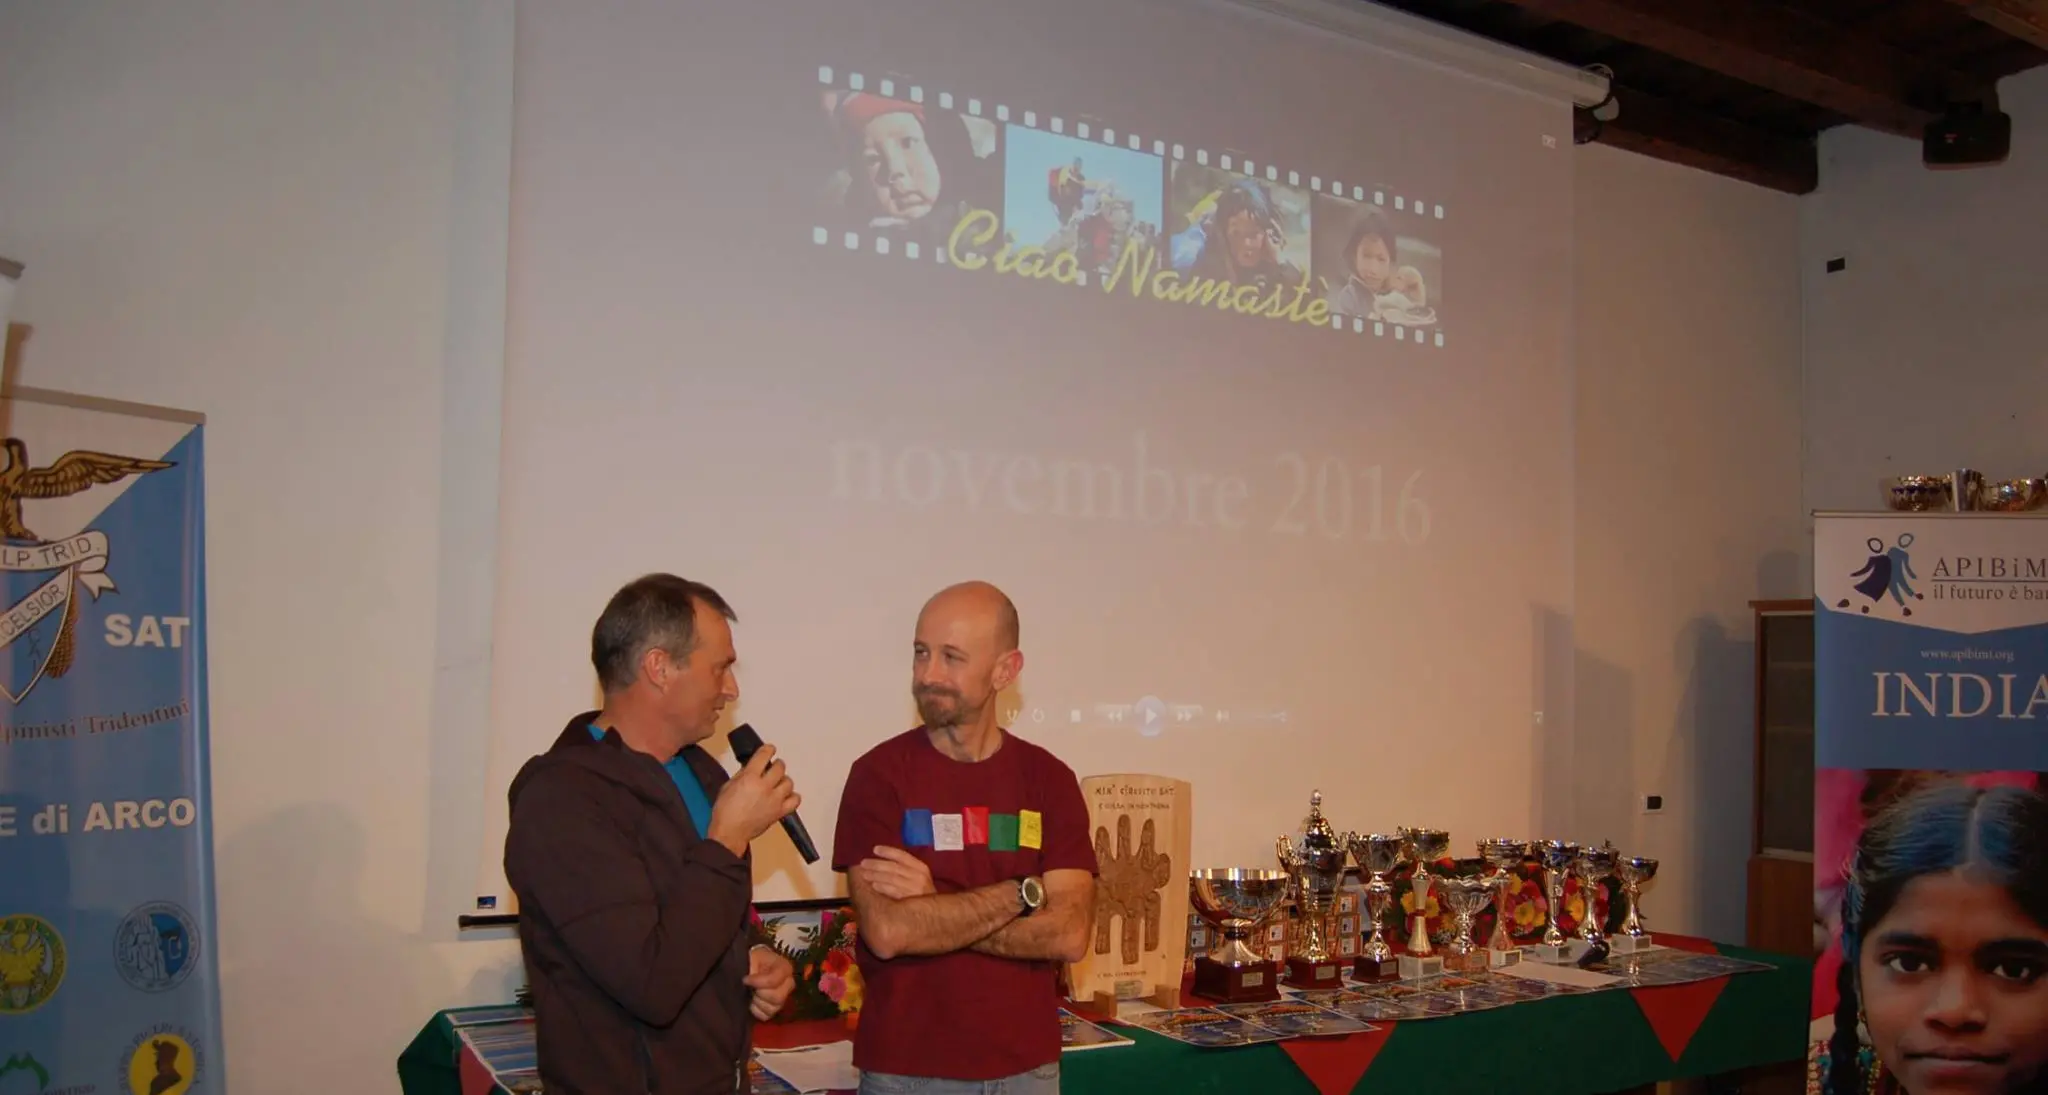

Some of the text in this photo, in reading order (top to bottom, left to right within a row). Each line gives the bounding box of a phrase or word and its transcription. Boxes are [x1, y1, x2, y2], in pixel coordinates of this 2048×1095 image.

[948, 208, 1330, 327] Ciao Namastè
[828, 429, 1433, 547] novembre 2016
[1933, 584, 1944, 600] il
[1950, 584, 2004, 600] futuro
[2009, 585, 2019, 600] è
[0, 582, 64, 641] CELSIOR
[103, 613, 191, 648] SAT
[1920, 648, 2014, 662] www.apibimi.org
[1871, 671, 2048, 719] INDIA
[82, 700, 190, 735] Tridentini
[32, 803, 68, 834] di
[83, 798, 196, 832] ARCO
